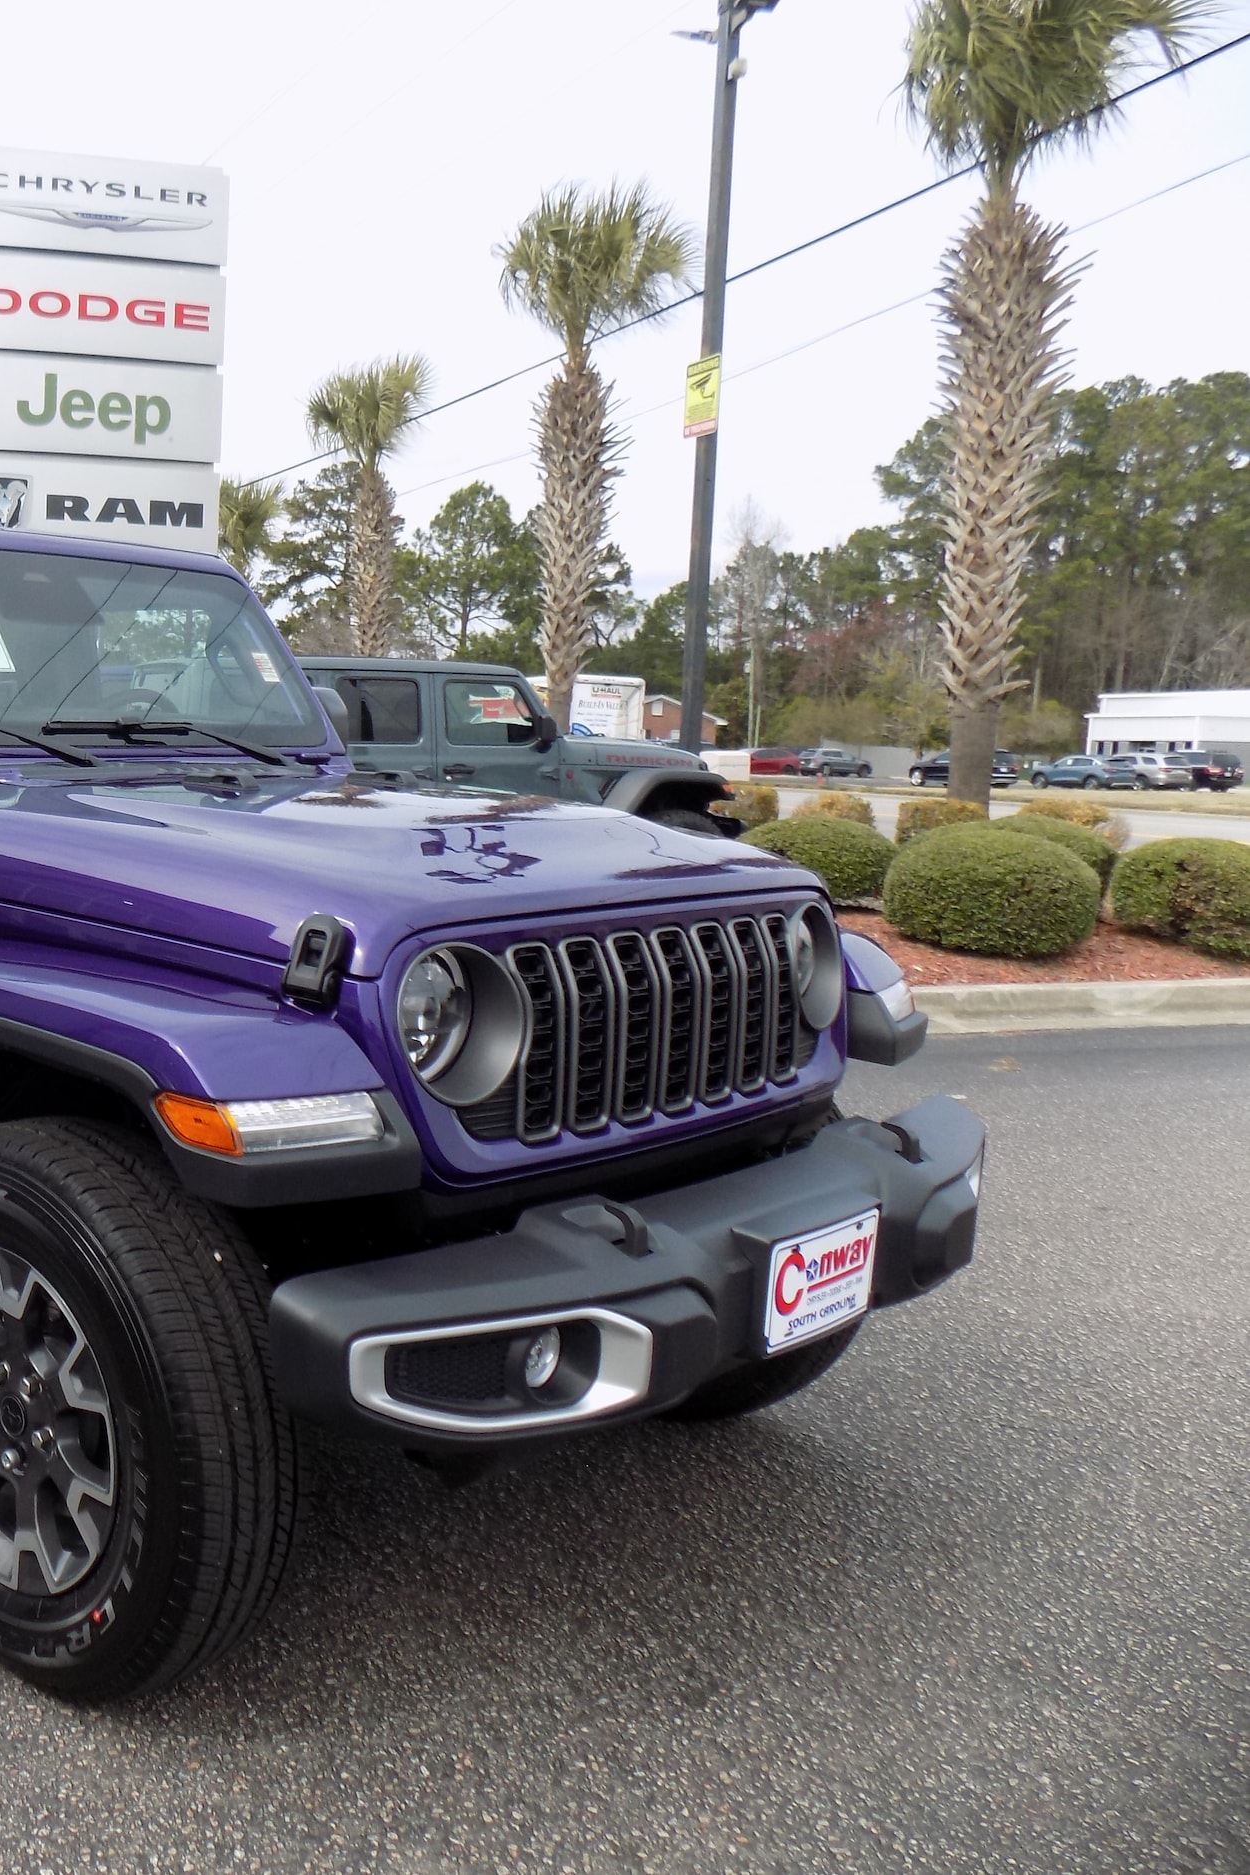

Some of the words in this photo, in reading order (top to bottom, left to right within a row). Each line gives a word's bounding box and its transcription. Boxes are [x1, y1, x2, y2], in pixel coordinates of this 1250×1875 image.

[16, 372, 172, 445] Jeep
[45, 493, 204, 529] RAM
[788, 1311, 817, 1331] SOUTH
